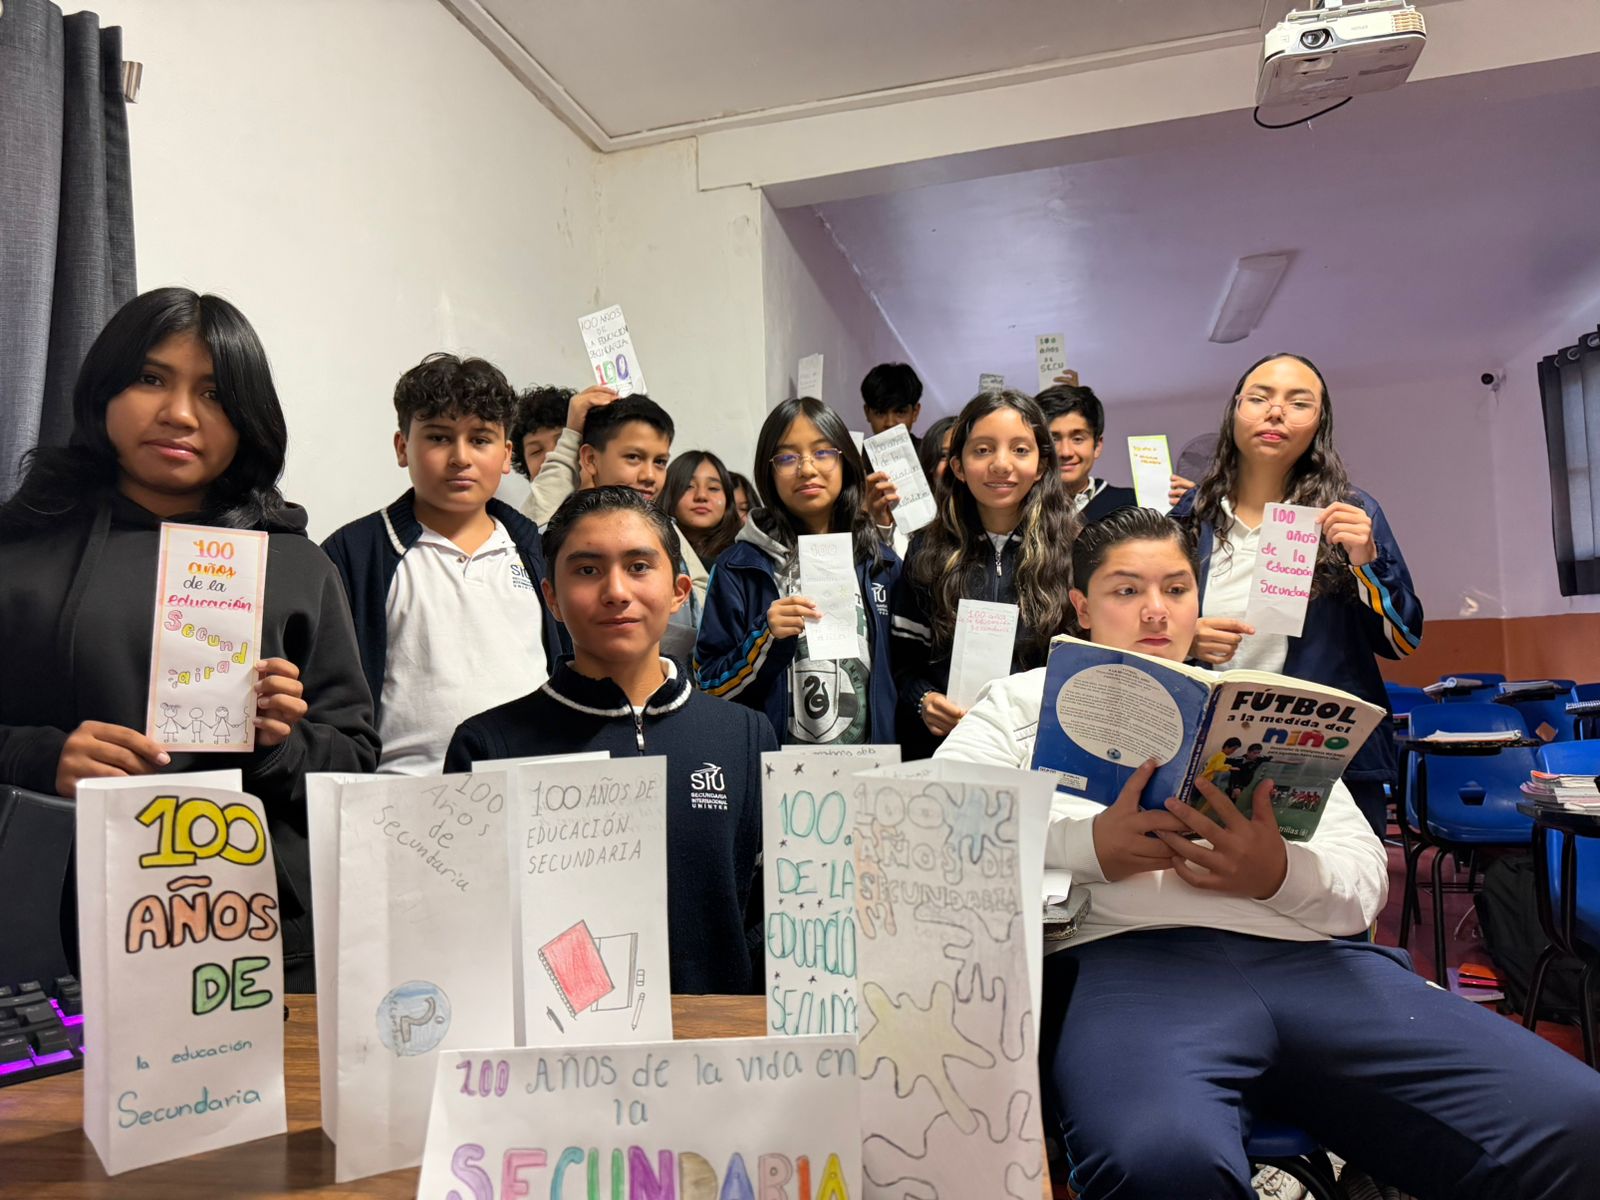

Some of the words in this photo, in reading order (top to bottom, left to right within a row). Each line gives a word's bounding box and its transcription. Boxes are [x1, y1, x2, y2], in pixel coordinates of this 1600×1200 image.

[595, 353, 629, 386] 100
[1272, 507, 1297, 525] 100
[193, 539, 235, 560] 100
[1261, 542, 1278, 557] de
[1292, 549, 1306, 564] la
[1286, 530, 1318, 544] años
[183, 576, 204, 591] de
[206, 579, 227, 593] la
[188, 562, 236, 578] años
[167, 594, 253, 613] educación
[1230, 688, 1357, 724] FÚTBOL
[1227, 714, 1236, 722] a
[1240, 713, 1255, 722] la
[1259, 715, 1320, 728] medida
[1325, 722, 1352, 734] del
[1262, 727, 1350, 751] niño
[454, 773, 505, 815] 100
[690, 770, 725, 791] SIU
[690, 792, 728, 800] SECUNDARIA
[421, 783, 490, 837] Años
[529, 780, 582, 817] 100
[586, 777, 631, 808] AÑOS
[636, 780, 656, 800] DE
[854, 783, 945, 830] 100
[135, 795, 266, 869] 100
[428, 818, 454, 849] de
[527, 811, 630, 849] EDUCACIÓN
[528, 839, 642, 875] SECUNDARIA
[981, 846, 1015, 878] DE
[776, 857, 816, 895] DE
[829, 857, 855, 899] LA
[125, 875, 279, 953] AÑOS
[193, 956, 273, 1016] DE
[136, 1055, 150, 1071] la
[170, 1039, 253, 1065] educación
[456, 1059, 510, 1098] 100
[525, 1054, 617, 1094] Años
[631, 1053, 669, 1089] de
[696, 1053, 723, 1086] la
[736, 1050, 804, 1082] vida
[815, 1047, 857, 1079] en
[117, 1087, 261, 1129] Secundaria
[613, 1097, 650, 1126] la
[445, 1142, 850, 1200] SECUNDARIA
